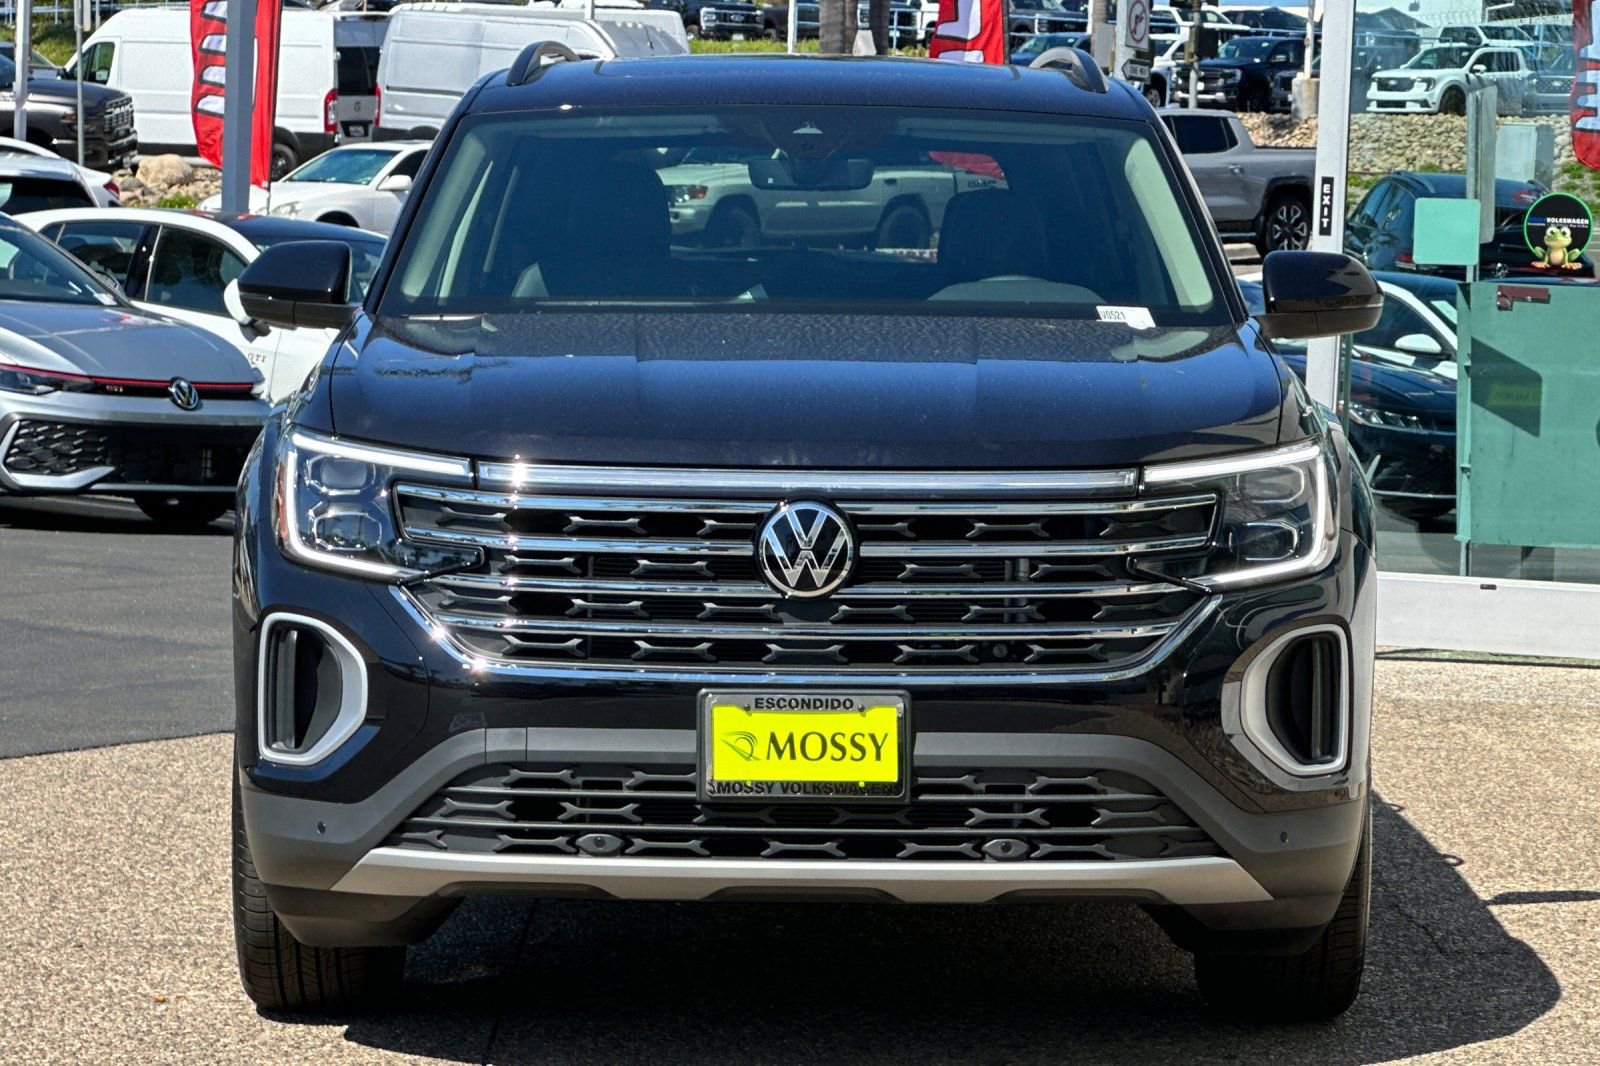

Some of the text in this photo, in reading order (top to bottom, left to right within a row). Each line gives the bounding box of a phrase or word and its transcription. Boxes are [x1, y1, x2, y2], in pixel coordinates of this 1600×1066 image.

[1321, 184, 1331, 228] EXIT
[1546, 216, 1589, 226] VOLKSWAGEN
[247, 352, 267, 364] GTI
[754, 697, 854, 711] ESCONDIDO
[765, 731, 889, 762] MOSSY
[717, 781, 894, 796] MOSSY VOLKSWAGEN
